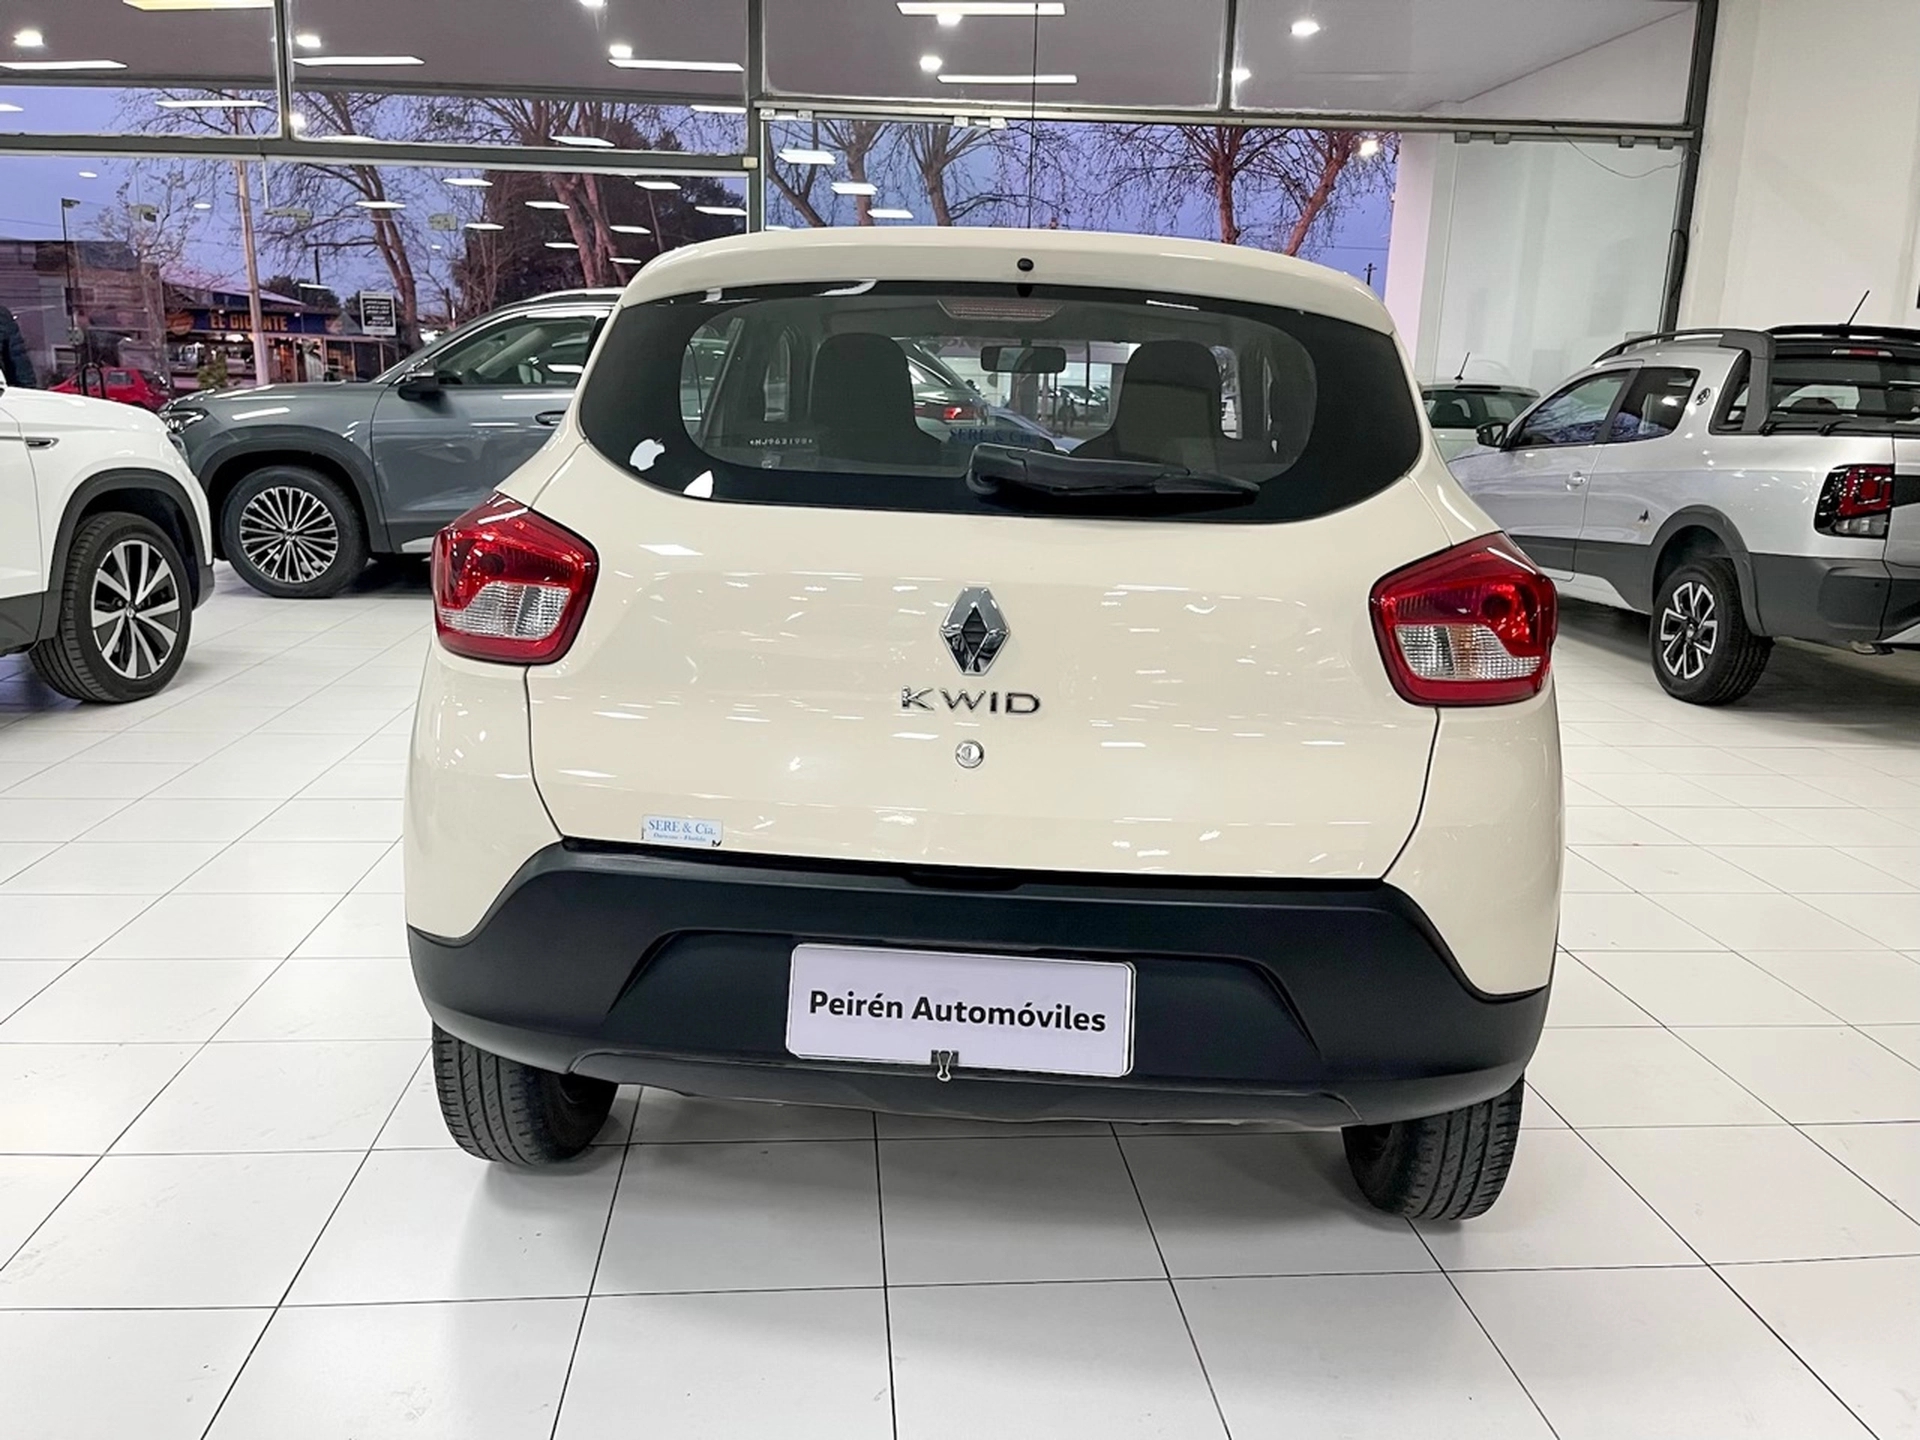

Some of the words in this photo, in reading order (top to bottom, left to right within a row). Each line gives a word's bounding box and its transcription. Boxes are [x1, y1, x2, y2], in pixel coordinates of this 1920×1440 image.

[211, 314, 226, 329] EL
[230, 314, 288, 331] GIGNTE
[902, 686, 1041, 714] KWID
[648, 819, 680, 833] SERE
[682, 822, 692, 834] &
[809, 989, 903, 1020] Peirén
[911, 996, 1107, 1033] Automóviles
